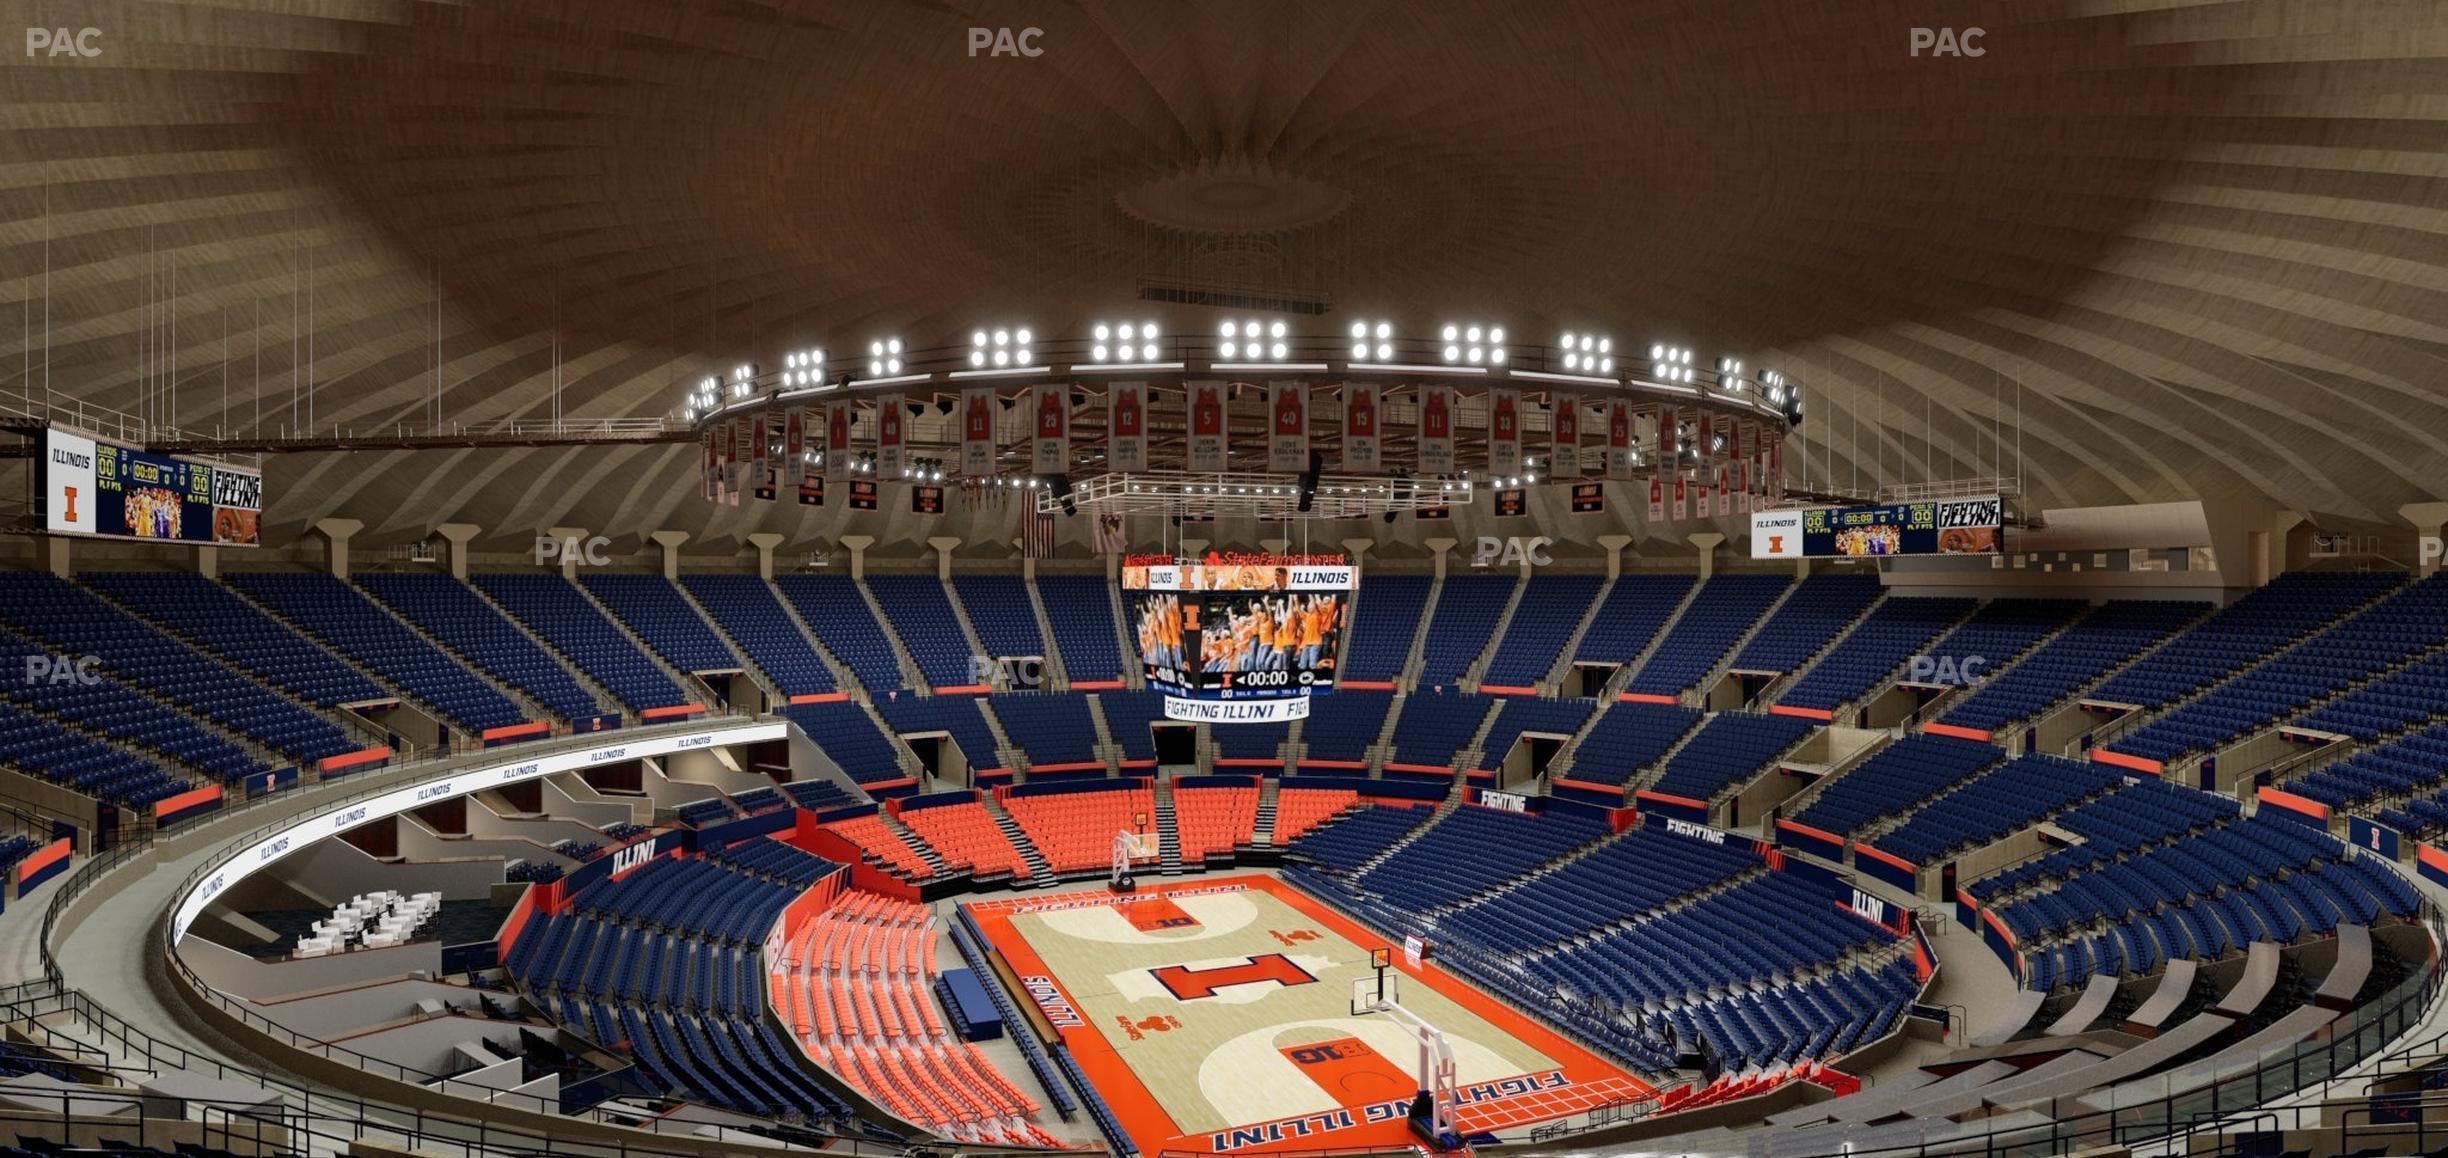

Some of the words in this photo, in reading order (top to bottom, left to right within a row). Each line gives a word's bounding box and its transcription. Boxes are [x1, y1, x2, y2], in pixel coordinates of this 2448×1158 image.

[52, 448, 90, 470] ILLINOIS
[99, 457, 113, 477] 00
[193, 475, 208, 492] 00
[215, 471, 261, 493] FIGHTING
[1914, 511, 1931, 521] 00
[1941, 500, 1998, 516] FIGHTING
[1756, 519, 1797, 528] ILLINOIS
[1807, 517, 1821, 527] 00
[1940, 511, 1998, 527] ILLINI
[1292, 572, 1349, 584] ILLINOIS
[1247, 671, 1288, 686] 00:00
[1221, 689, 1233, 698] 00
[1300, 686, 1311, 696] 00
[1167, 700, 1220, 718] FIGHTING
[1223, 704, 1275, 719] ILLINI
[678, 736, 712, 747] ILLINOIS
[591, 748, 626, 762] ILLINOIS
[503, 763, 539, 779] ILLINOIS
[417, 783, 451, 800] ILLINOIS
[1481, 791, 1526, 813] FIGHTING
[334, 807, 366, 828] ILLINOIS
[1666, 818, 1726, 845] FIGHTING
[261, 836, 289, 860] ILLINOIS
[612, 838, 656, 875] ILLINI
[1852, 889, 1884, 924] ILLINI
[1021, 975, 1086, 1028] ILLINOIS
[1212, 1108, 1356, 1153] ILLINI
